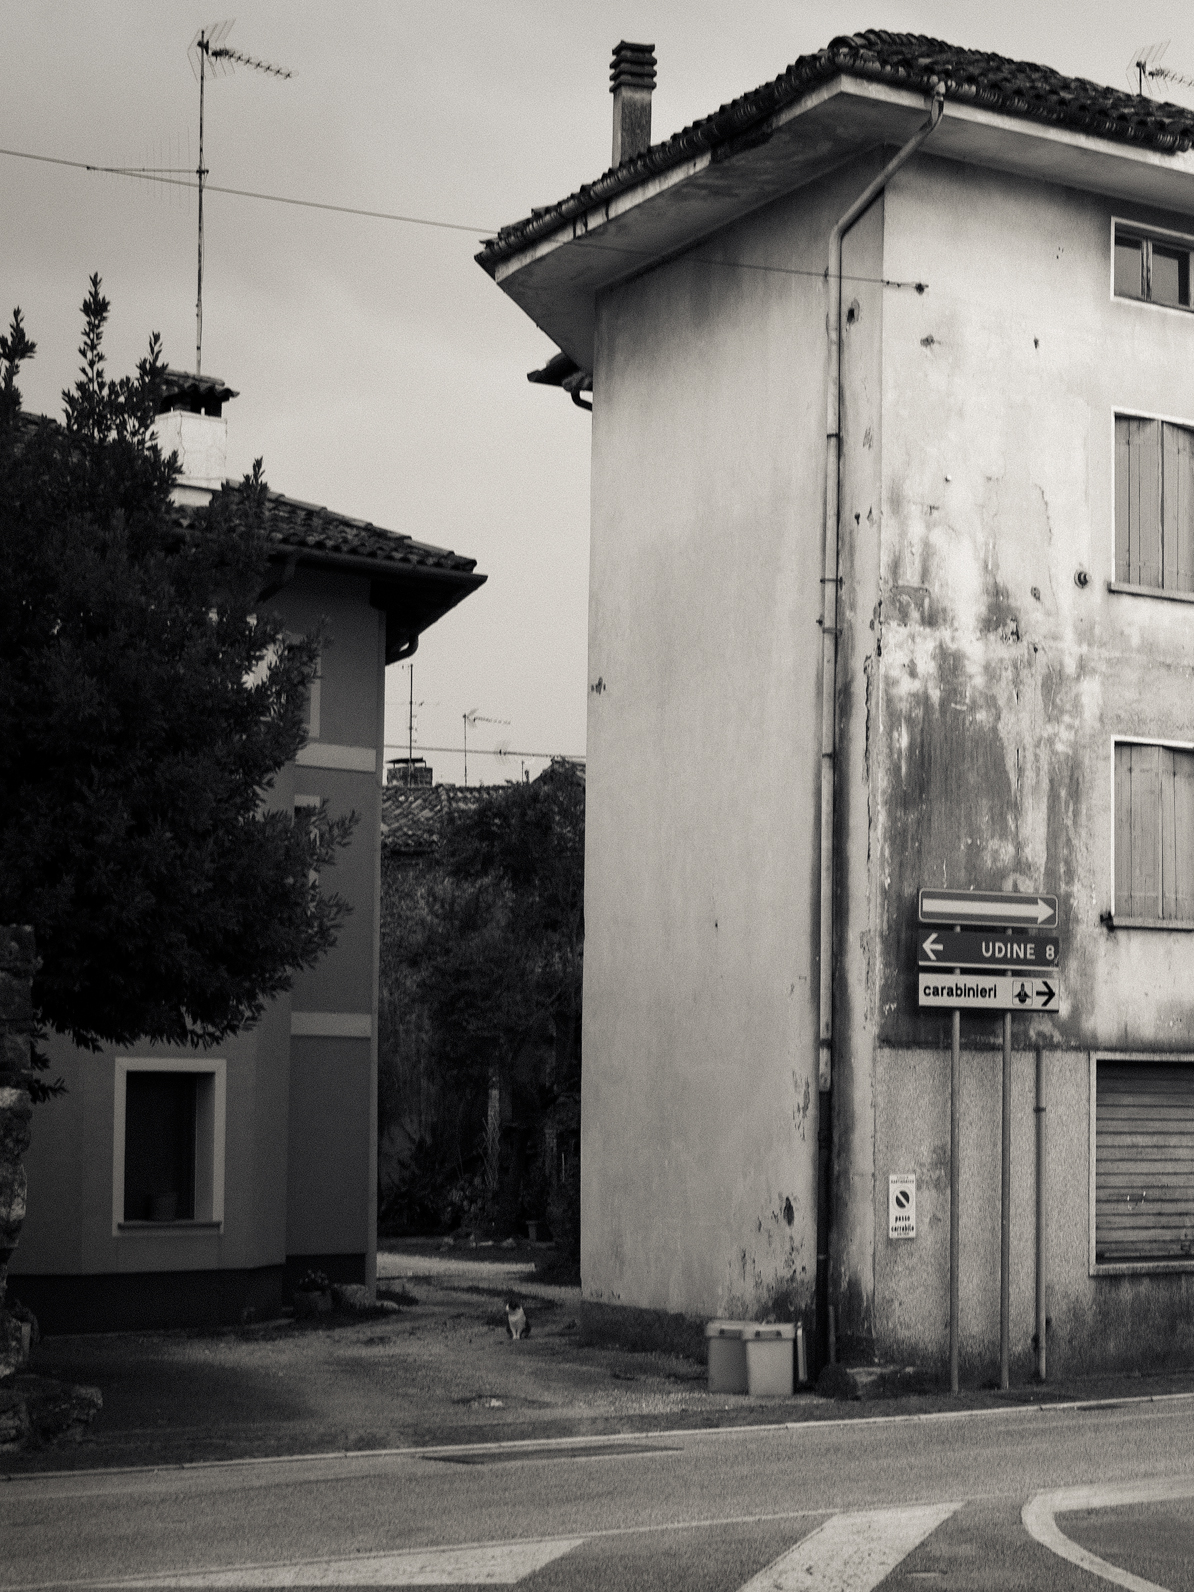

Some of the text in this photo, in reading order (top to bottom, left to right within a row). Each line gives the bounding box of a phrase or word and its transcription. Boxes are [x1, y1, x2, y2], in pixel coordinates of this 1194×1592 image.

[981, 940, 1055, 960] UDINE 8
[923, 982, 997, 999] carabinieri
